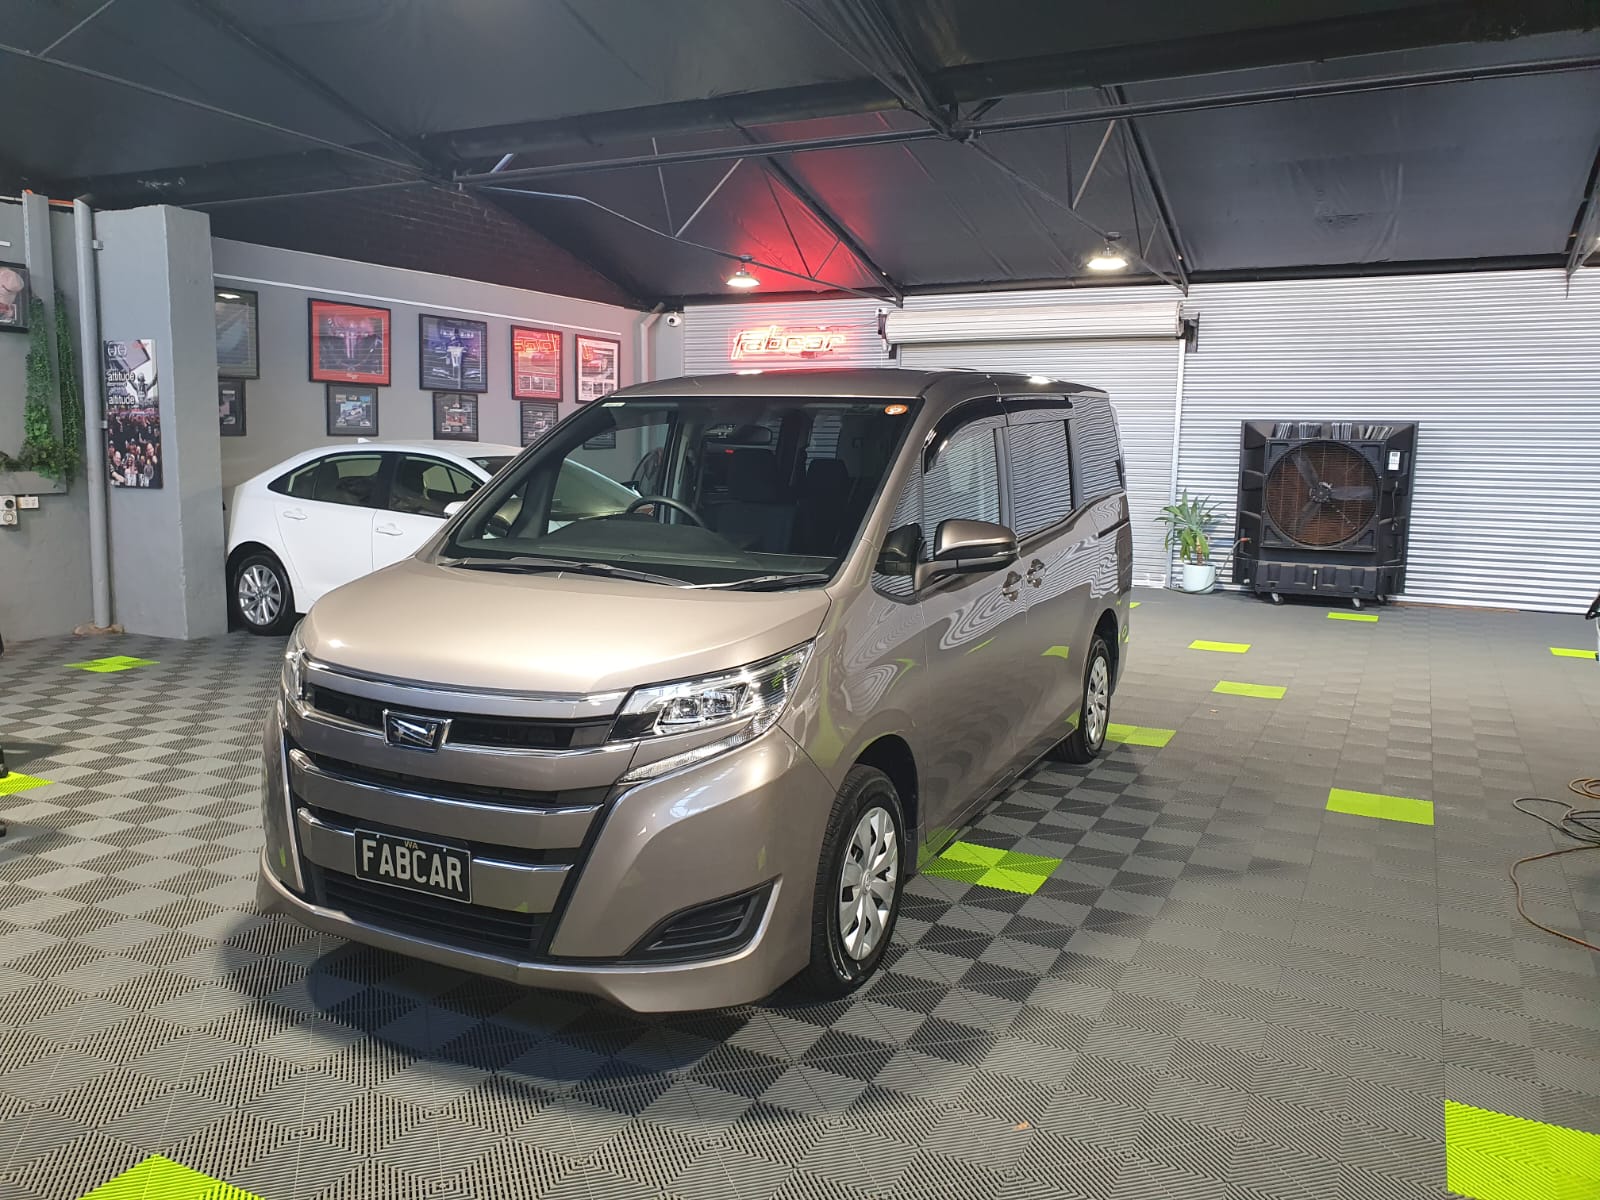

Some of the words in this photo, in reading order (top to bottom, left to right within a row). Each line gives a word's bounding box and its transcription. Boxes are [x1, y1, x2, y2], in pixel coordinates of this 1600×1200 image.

[731, 325, 845, 359] fabcar
[404, 841, 418, 849] WA
[362, 839, 463, 893] FABCAR
